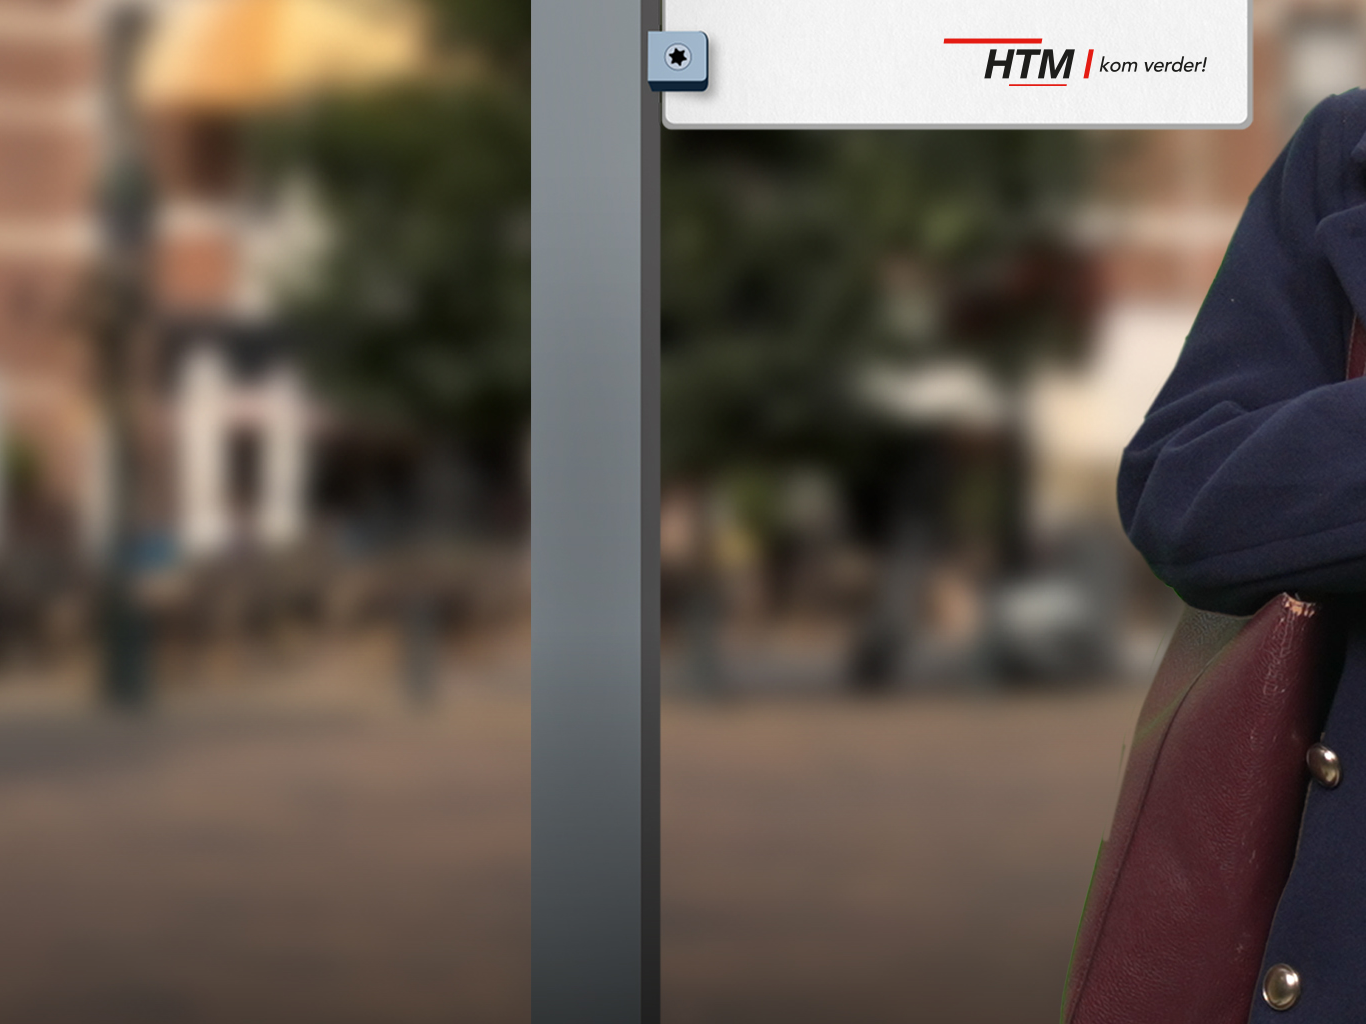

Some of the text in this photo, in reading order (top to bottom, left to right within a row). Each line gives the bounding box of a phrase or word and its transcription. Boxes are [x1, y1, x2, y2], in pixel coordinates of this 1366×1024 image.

[984, 49, 1208, 79] HTM kom verder!
